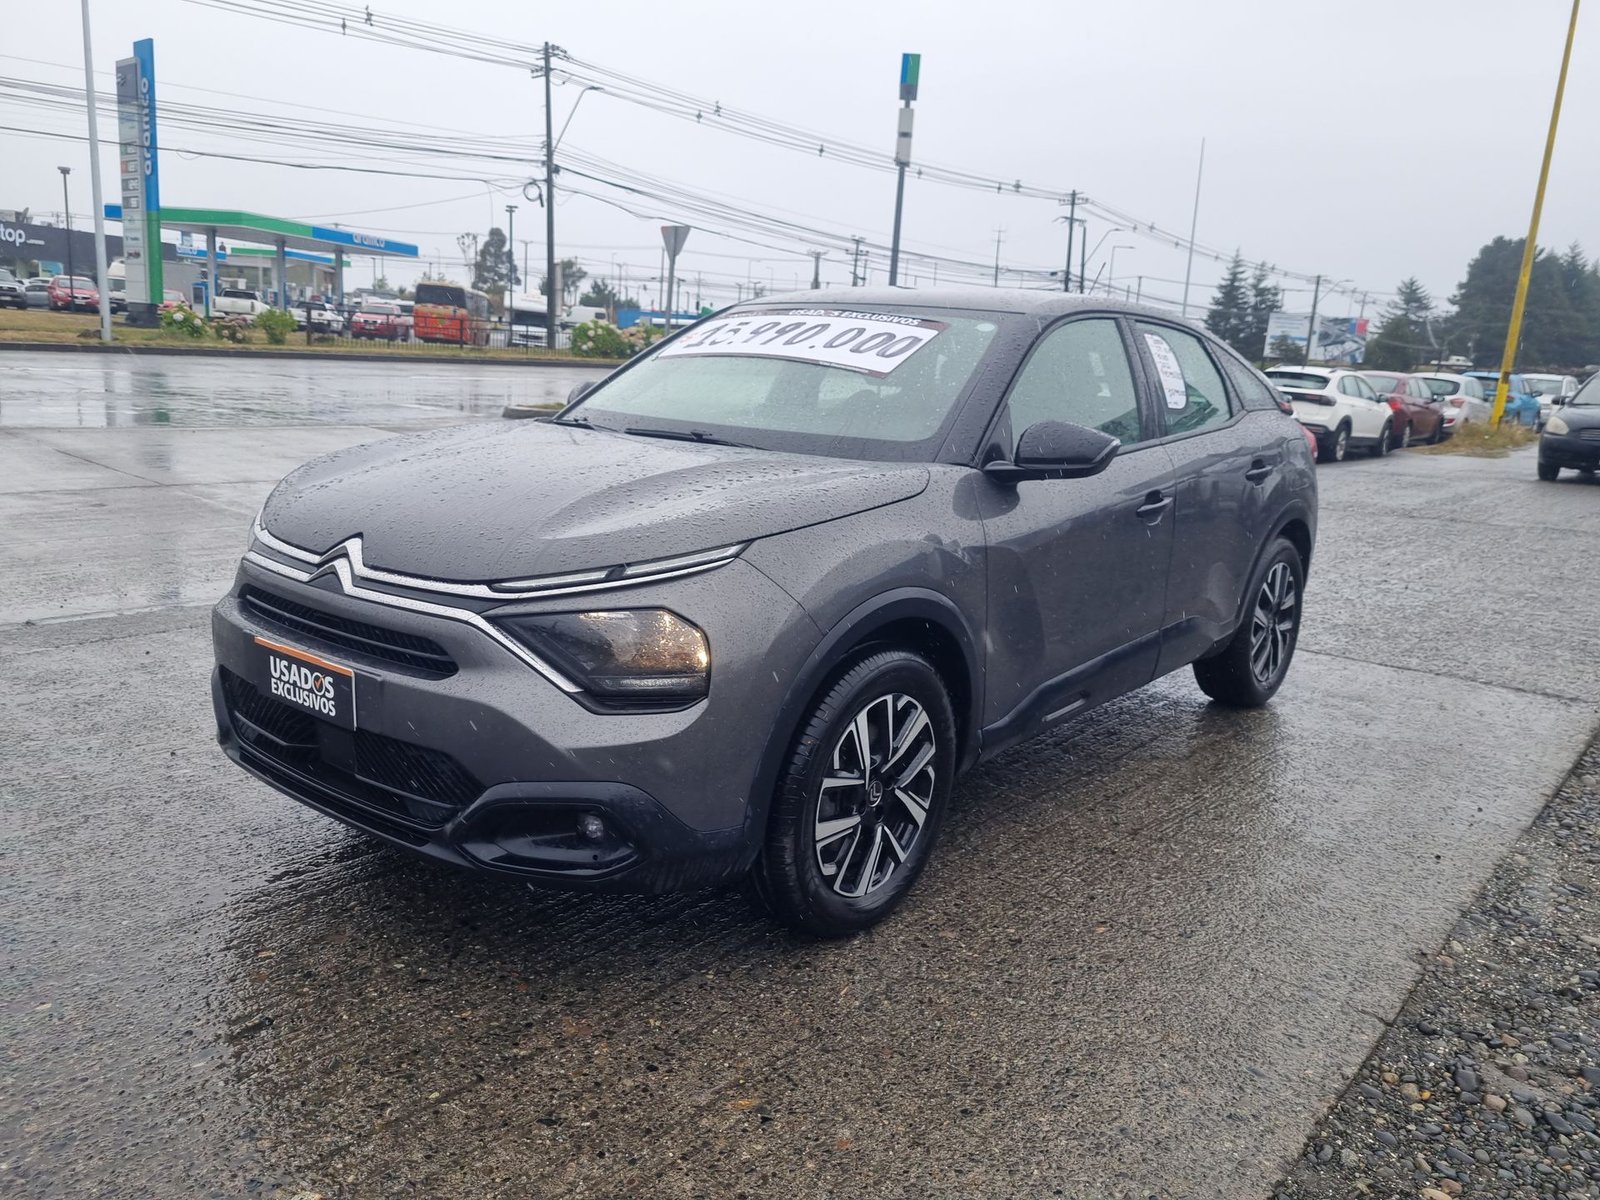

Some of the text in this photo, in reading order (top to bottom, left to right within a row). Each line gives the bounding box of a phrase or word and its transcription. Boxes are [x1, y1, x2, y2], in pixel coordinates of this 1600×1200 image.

[141, 77, 152, 176] aramco
[788, 309, 922, 326] USADS EXCLUSIVOS
[269, 655, 335, 699] USADOS
[270, 678, 336, 717] EXCLUSIVOS
